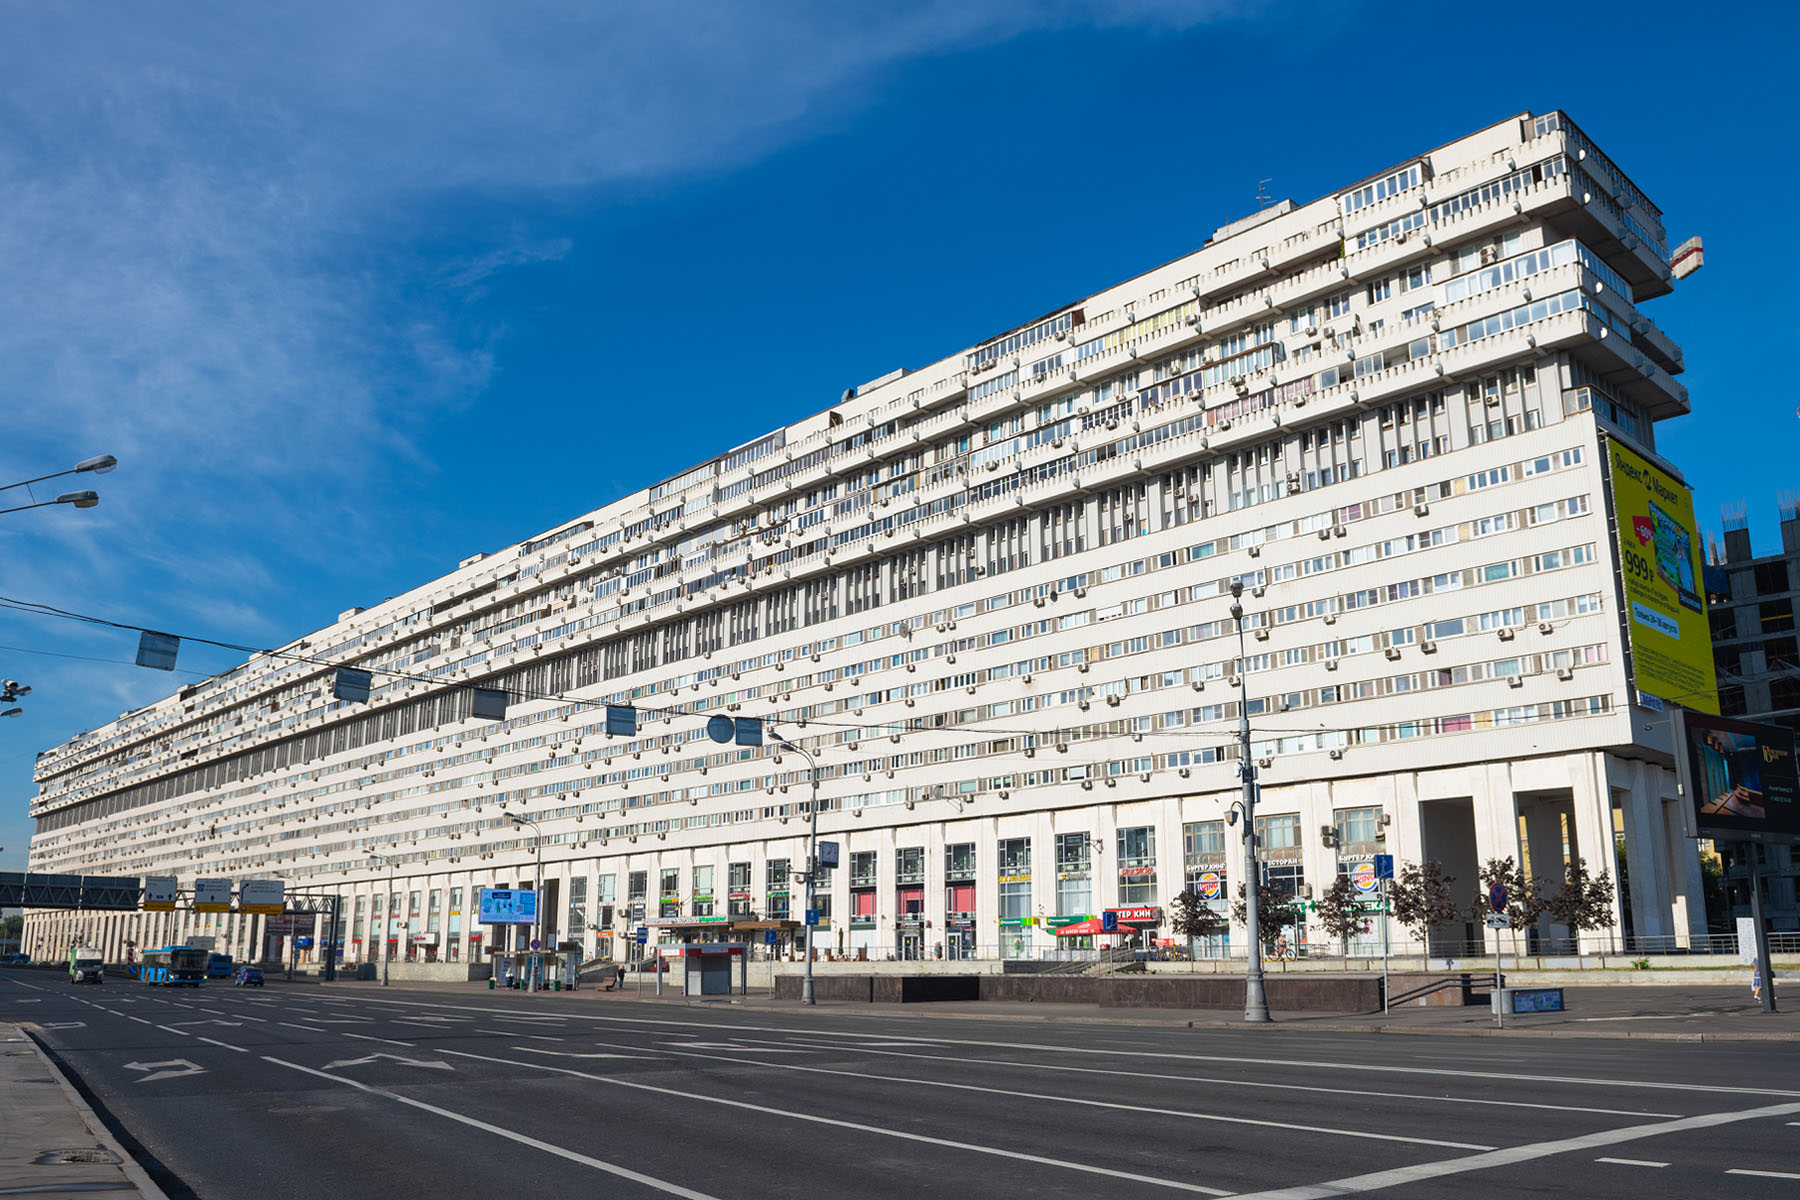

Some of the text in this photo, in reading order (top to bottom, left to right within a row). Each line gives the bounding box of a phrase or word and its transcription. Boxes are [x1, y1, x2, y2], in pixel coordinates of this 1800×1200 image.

[1615, 453, 1679, 505] Яндекс Маркет
[1267, 858, 1297, 866] ЕСТОРАН
